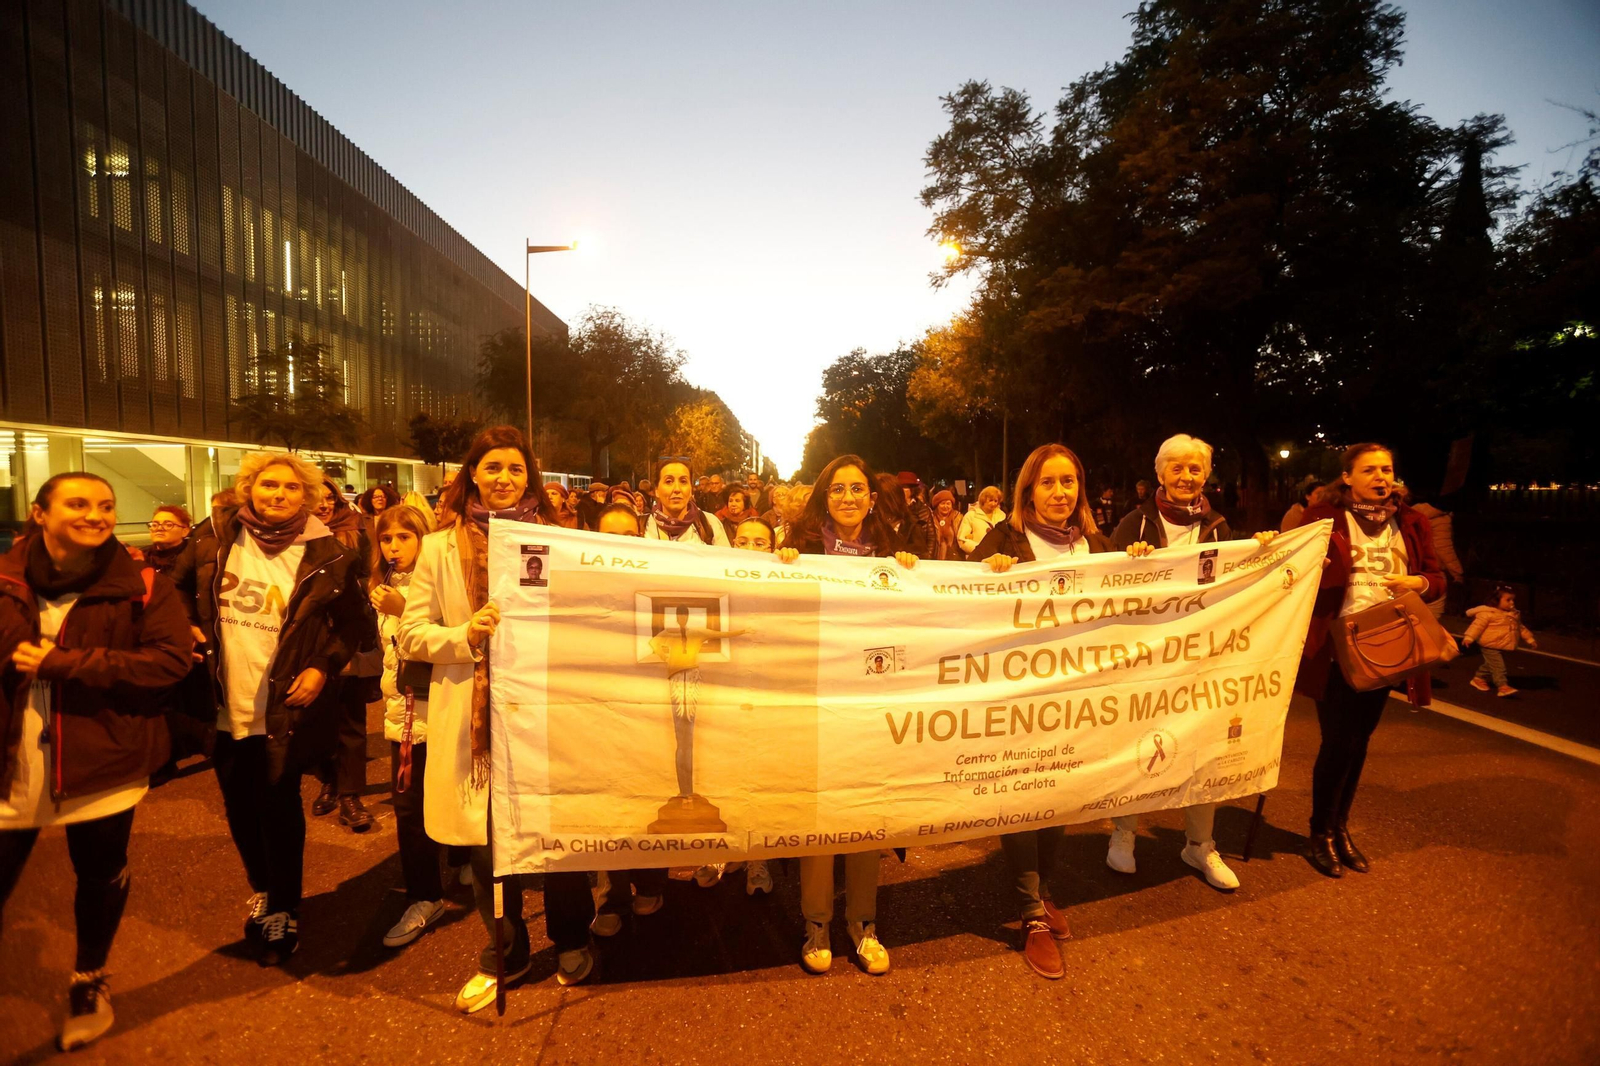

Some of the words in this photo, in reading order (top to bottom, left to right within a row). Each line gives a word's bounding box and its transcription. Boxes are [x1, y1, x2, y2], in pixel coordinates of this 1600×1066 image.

[580, 552, 605, 566] LA
[611, 557, 649, 570] PAZ
[1222, 562, 1236, 574] EL
[724, 569, 761, 579] LOS
[1100, 568, 1174, 588] ARRECIFE
[932, 578, 1041, 596] MONTEALTO
[1013, 598, 1061, 629] LA
[240, 619, 252, 627] de
[253, 621, 280, 633] Córdo
[937, 651, 990, 685] EN
[1002, 641, 1153, 682] CONTRA
[1162, 632, 1202, 664] DE
[1208, 626, 1250, 658] LAS
[885, 695, 1118, 745] VIOLENCIAS
[1128, 670, 1282, 723] MACHISTAS
[955, 753, 997, 765] Centro
[1002, 745, 1057, 761] Municipal
[1061, 744, 1075, 755] de
[943, 765, 1018, 783] Información
[1034, 763, 1045, 773] la
[1049, 759, 1083, 773] Mujer
[973, 784, 988, 796] de
[993, 782, 1008, 794] La
[1013, 778, 1056, 792] Carlota
[1202, 773, 1243, 789] ALDEA
[917, 824, 938, 836] EL
[943, 808, 1055, 833] RINCONCILLO
[541, 837, 565, 851] LA
[570, 838, 633, 853] CHICA
[637, 837, 729, 851] CARLOTA
[764, 835, 800, 848] LAS
[805, 828, 886, 846] PINEDAS
